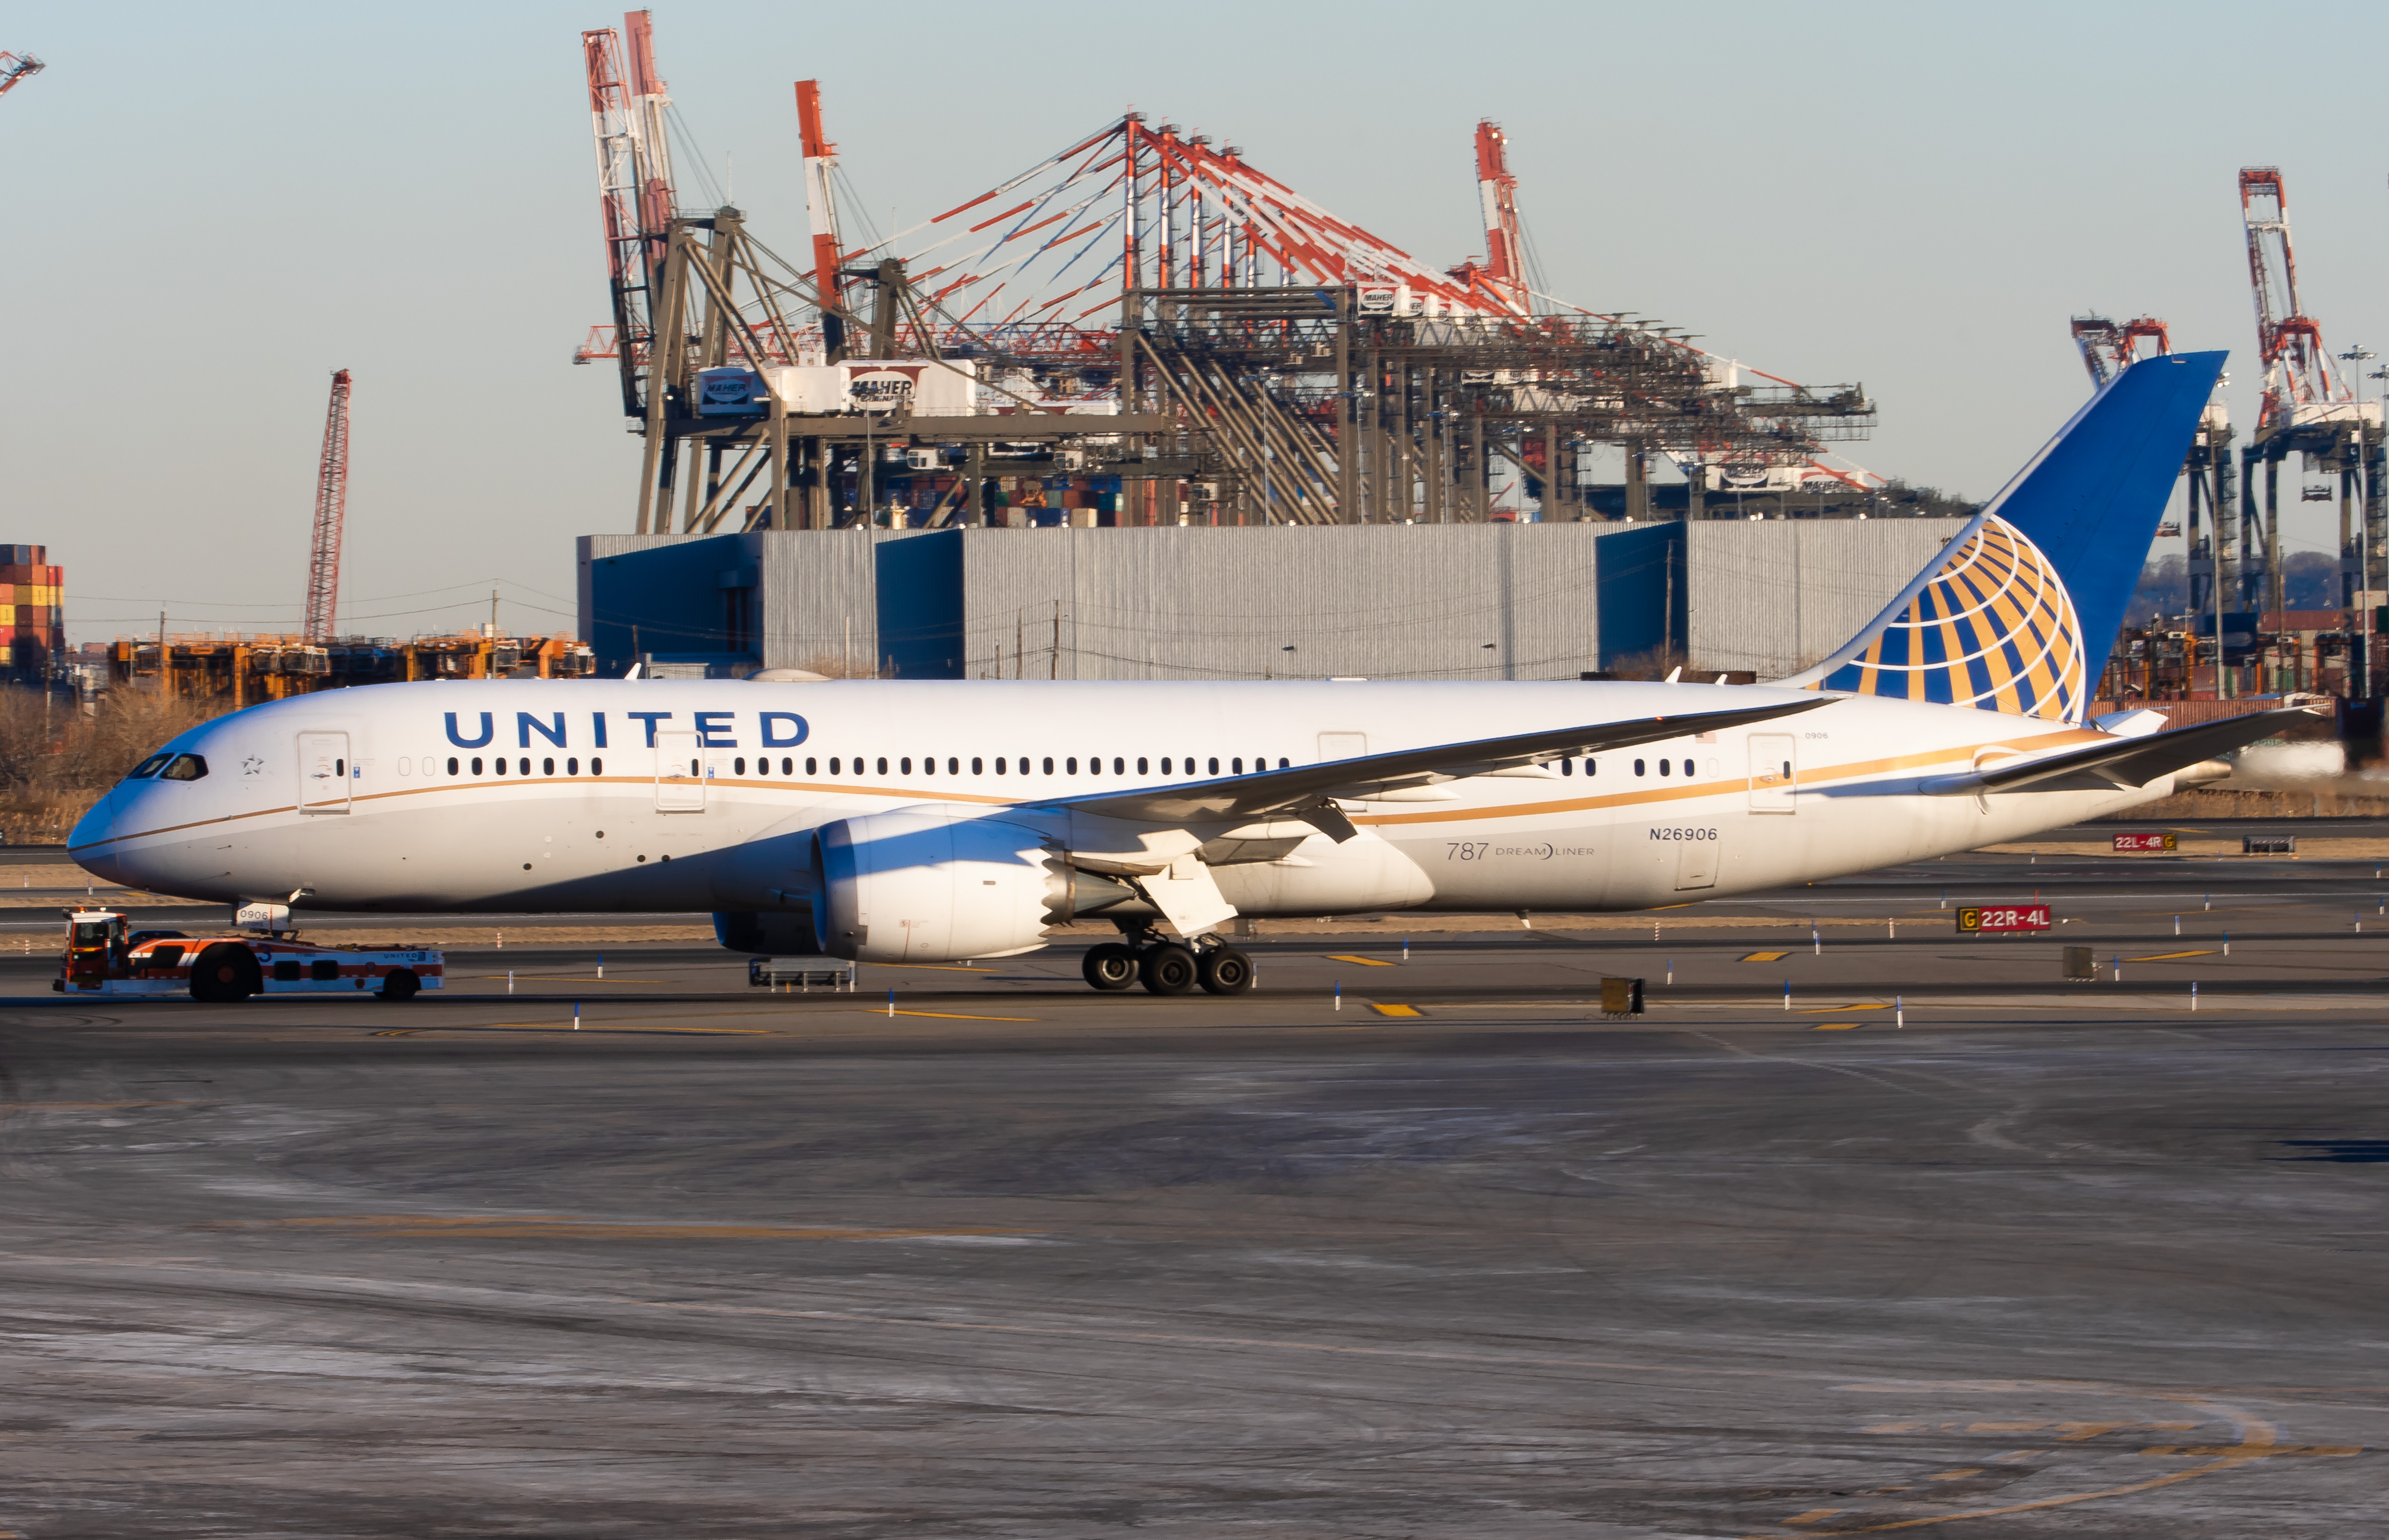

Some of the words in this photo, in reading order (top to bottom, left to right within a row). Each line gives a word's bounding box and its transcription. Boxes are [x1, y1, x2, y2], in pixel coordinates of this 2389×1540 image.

[444, 712, 809, 749] UNITED
[1649, 828, 1718, 841] N26906
[2115, 836, 2163, 848] 22L-4R
[2165, 837, 2174, 847] G
[1447, 842, 1489, 860] 787
[240, 910, 269, 920] 0906
[1964, 912, 1976, 927] G
[1981, 910, 2050, 927] 22R-4L
[258, 944, 272, 963] 3
